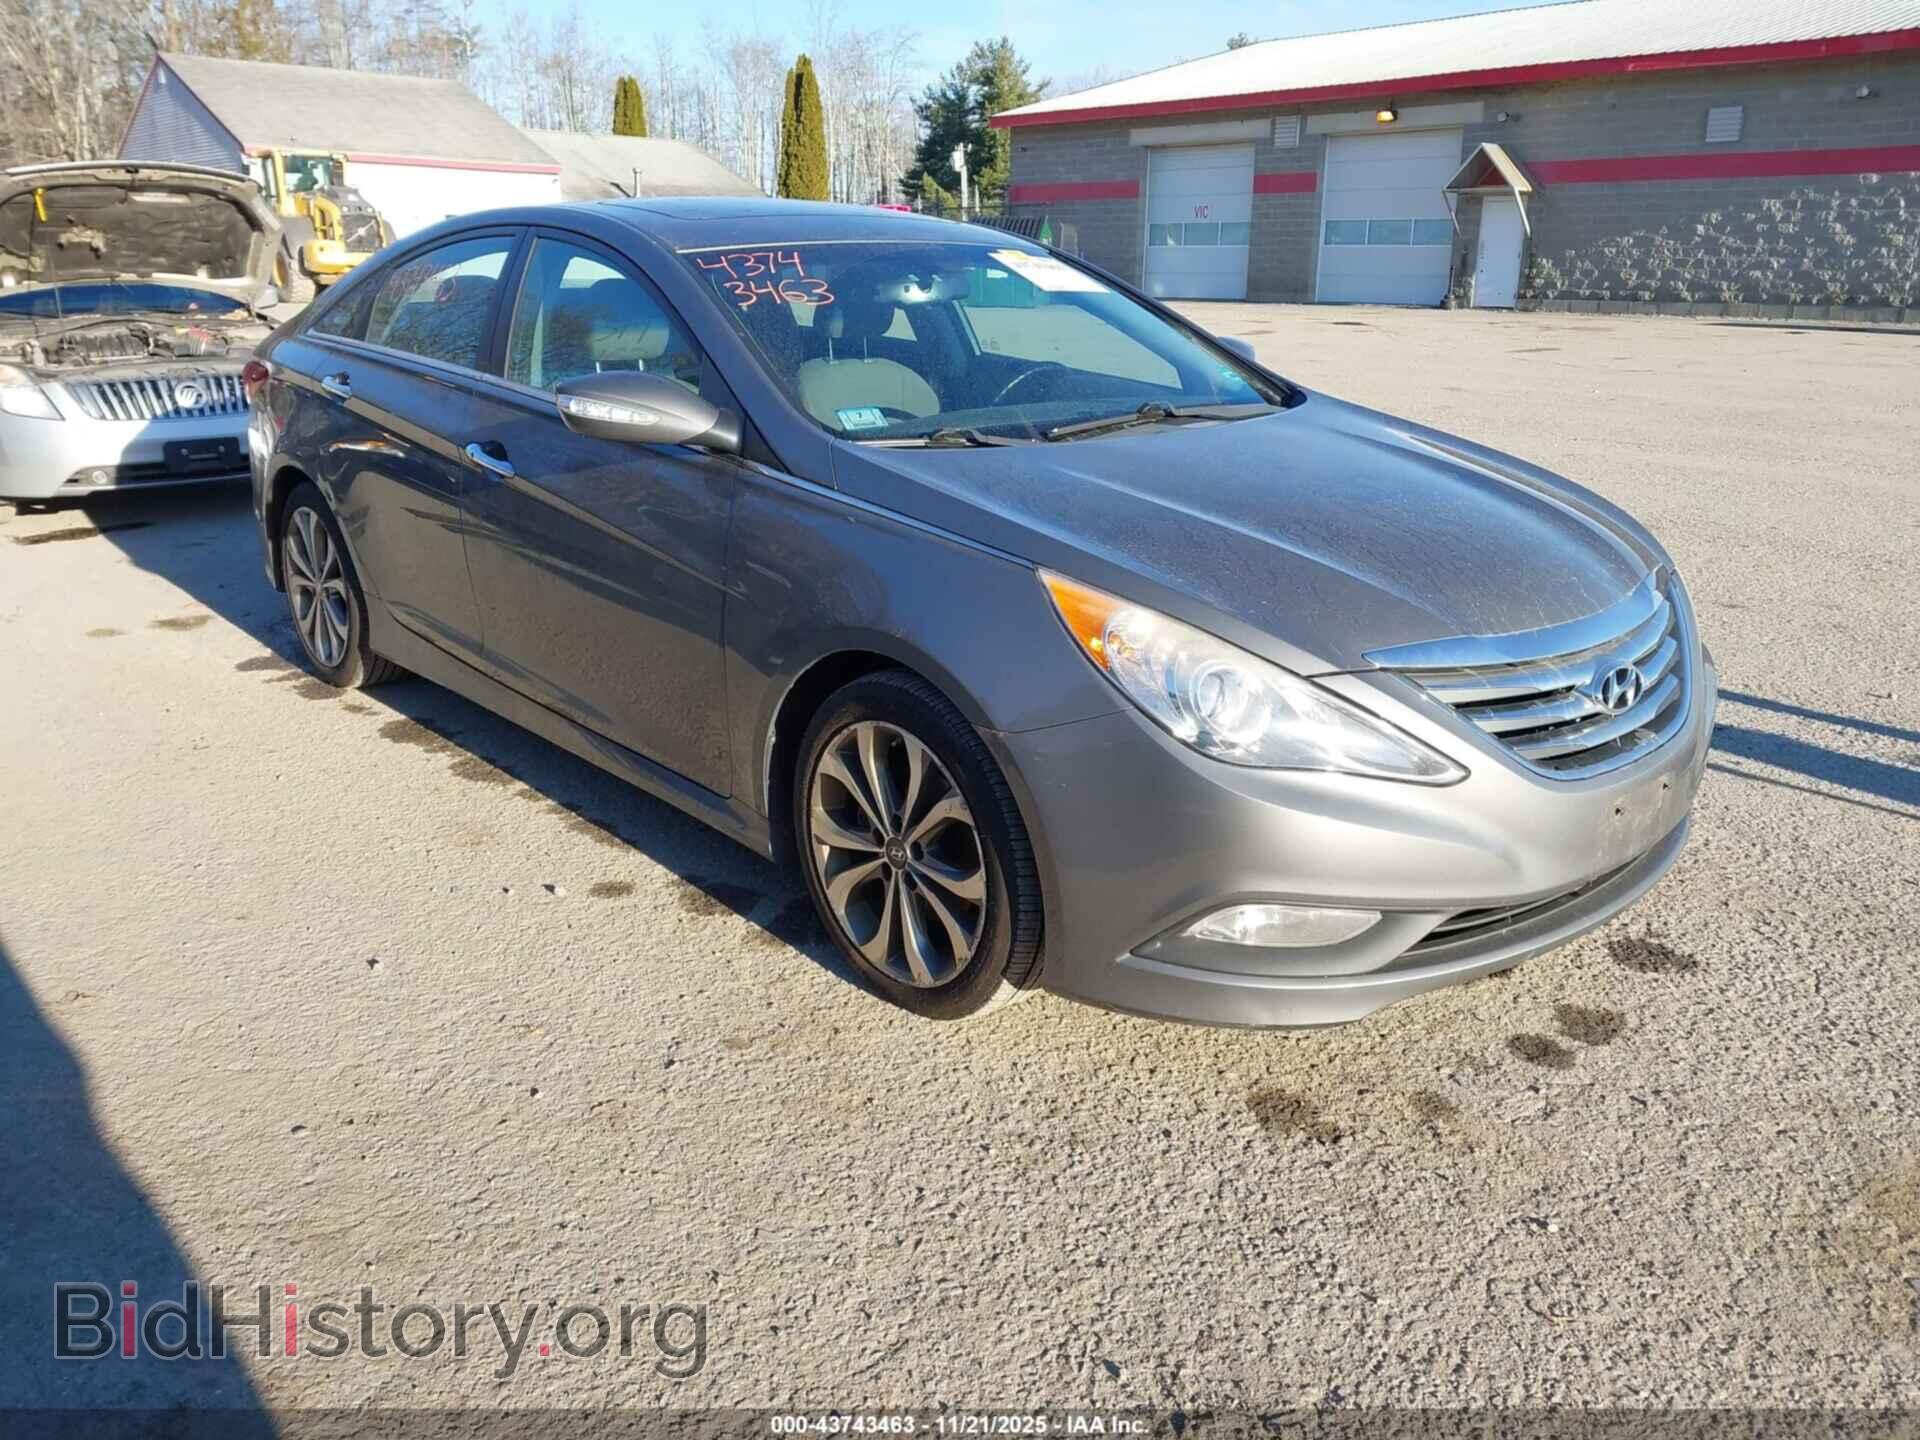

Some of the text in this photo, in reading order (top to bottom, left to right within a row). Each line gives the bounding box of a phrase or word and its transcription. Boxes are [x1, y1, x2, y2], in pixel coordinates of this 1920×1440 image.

[1194, 205, 1209, 219] VIC
[696, 251, 804, 279] 4374
[723, 279, 835, 306] 3463
